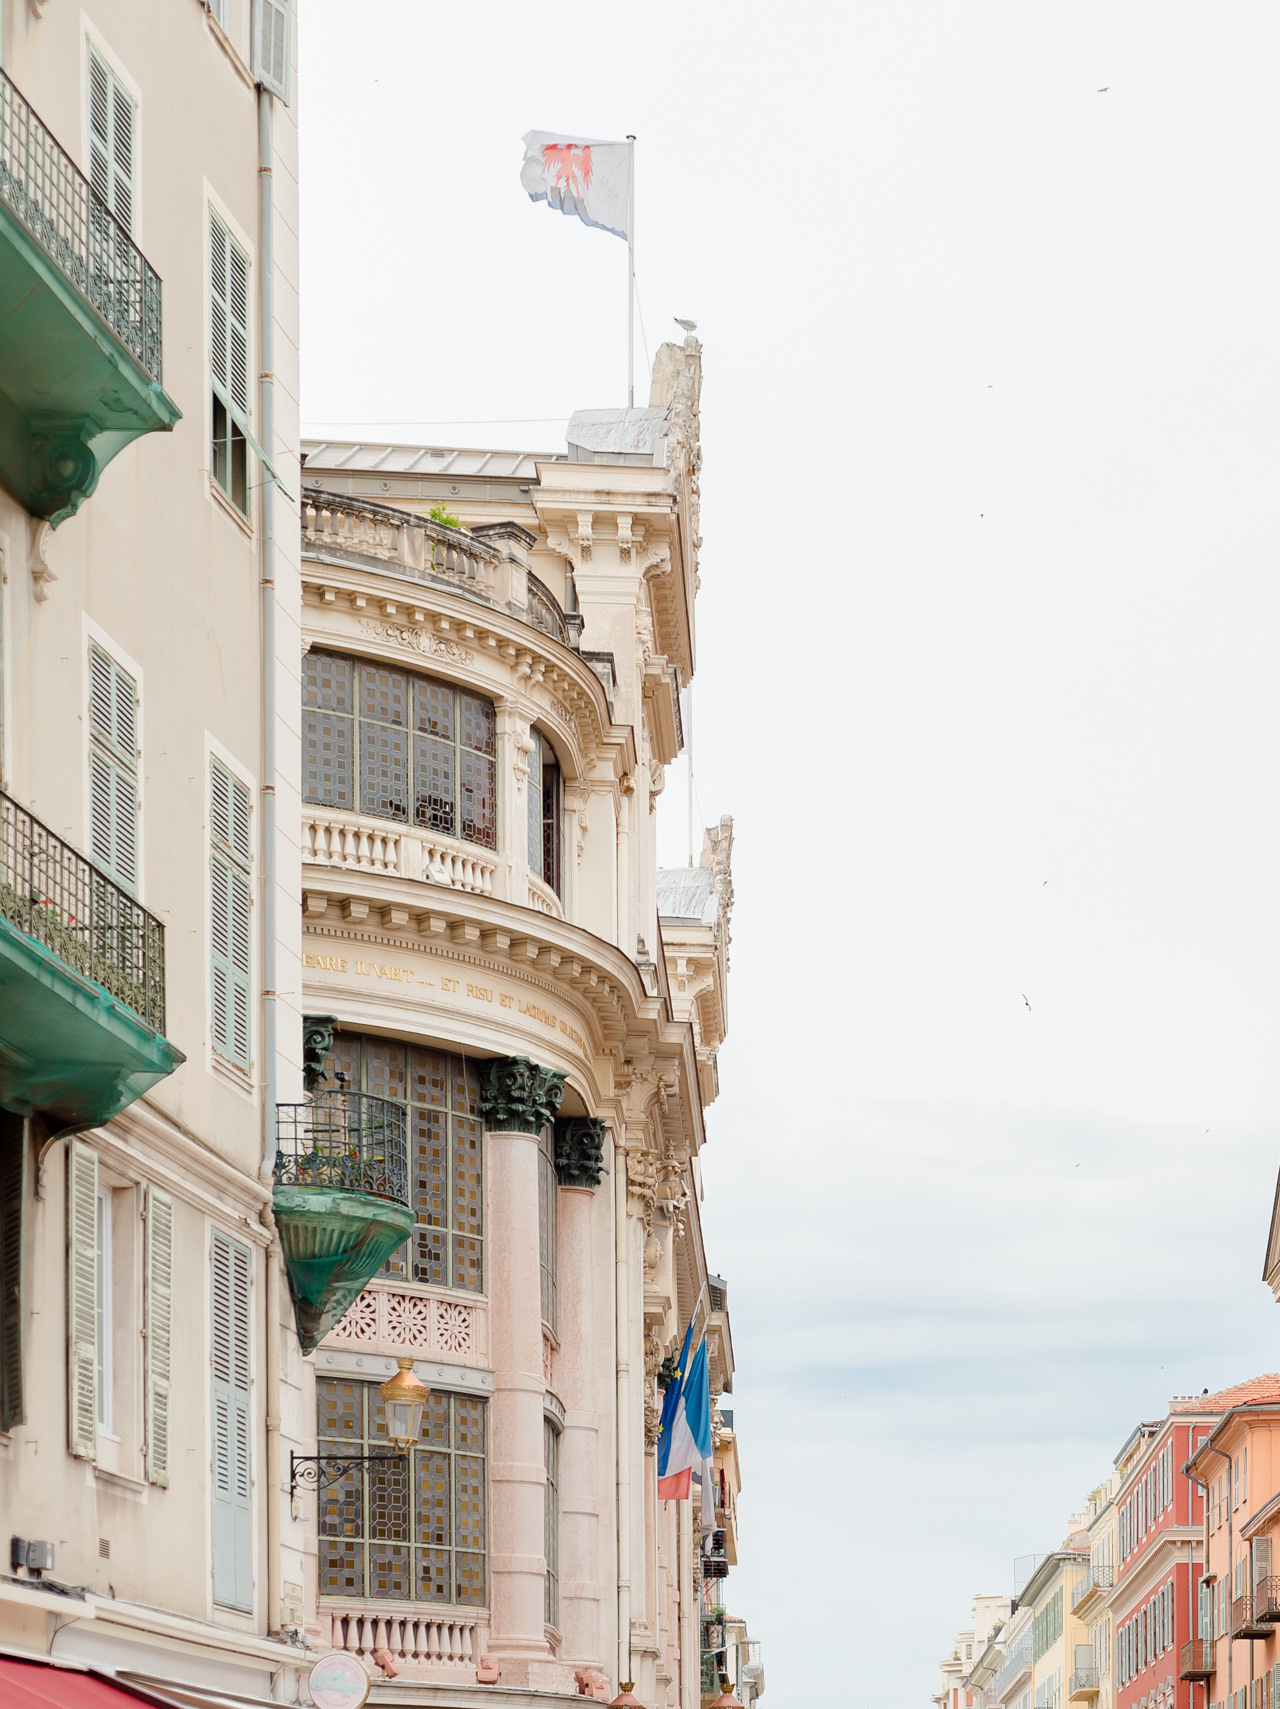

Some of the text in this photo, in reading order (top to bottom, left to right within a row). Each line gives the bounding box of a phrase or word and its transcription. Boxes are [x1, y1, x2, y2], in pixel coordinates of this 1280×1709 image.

[356, 960, 414, 983] IUVABIT
[441, 977, 459, 993] ET
[466, 983, 493, 1002] RISU
[499, 992, 514, 1008] ET
[518, 999, 557, 1028] LACRYMIS
